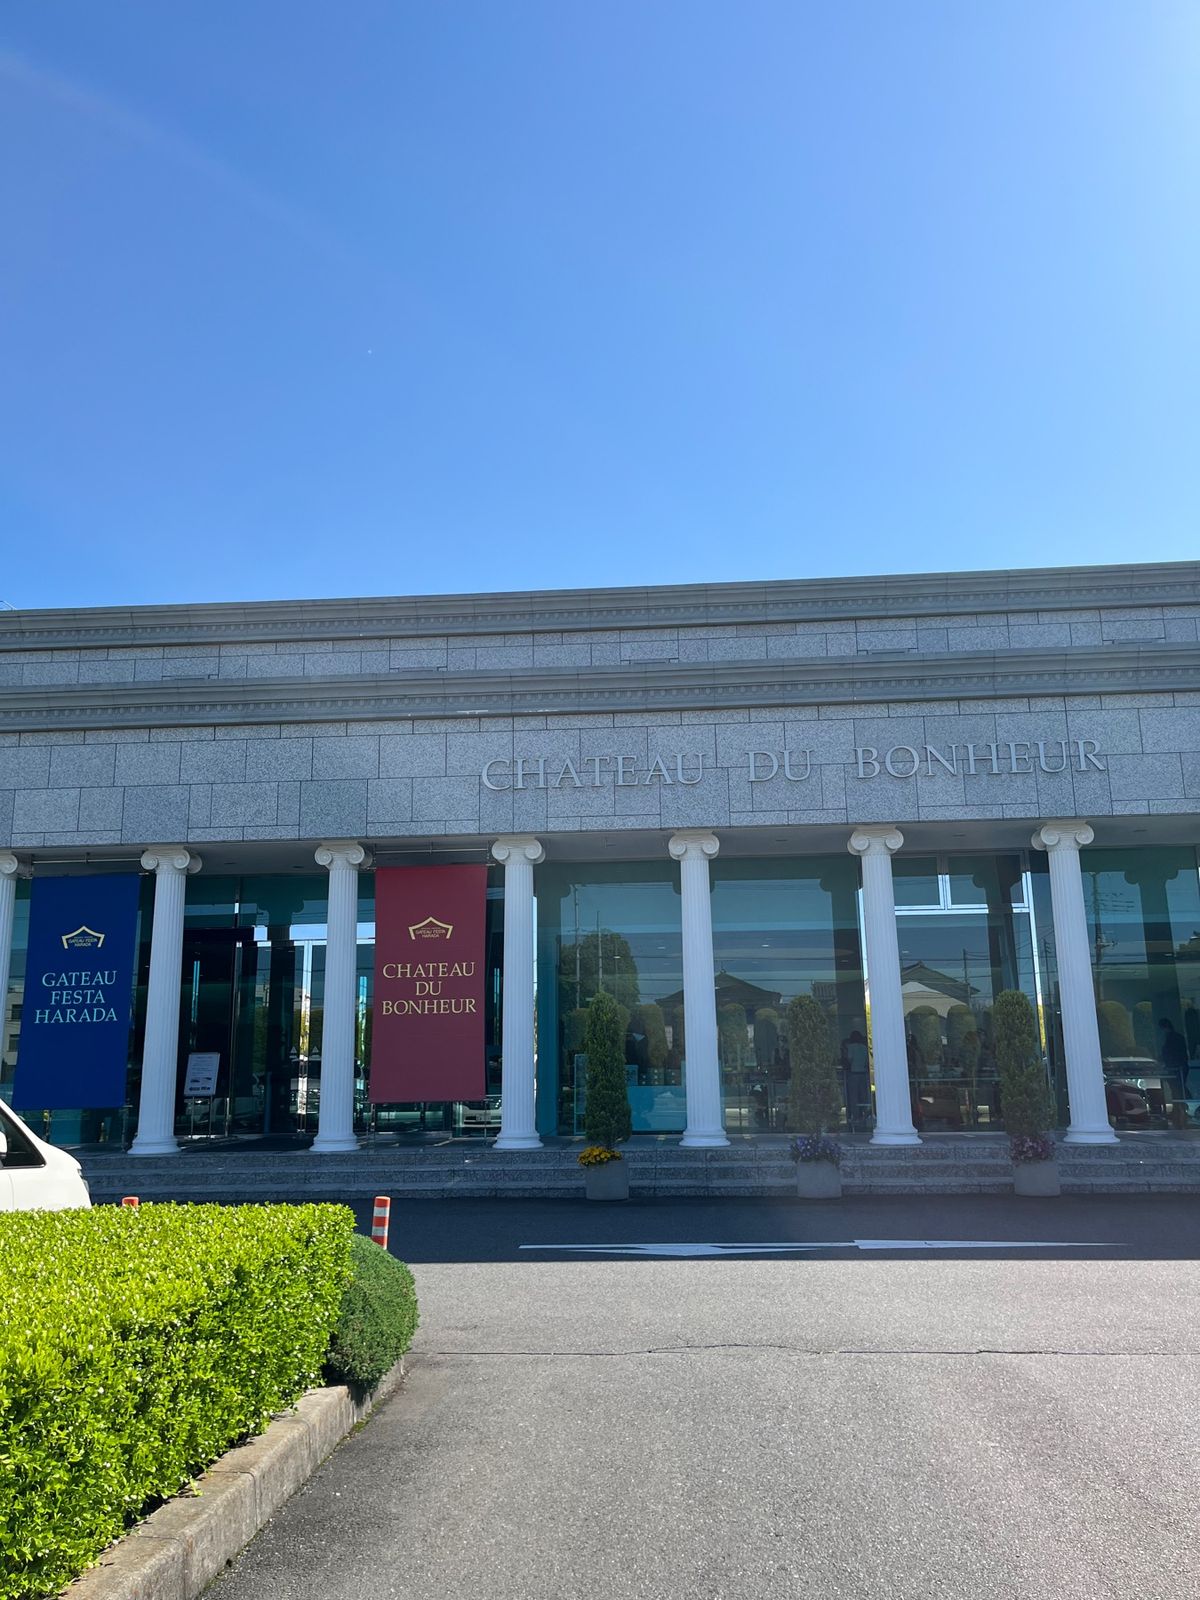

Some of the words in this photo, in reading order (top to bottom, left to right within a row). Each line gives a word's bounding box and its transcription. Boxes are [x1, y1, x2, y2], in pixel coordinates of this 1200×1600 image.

[481, 752, 706, 791] CHATEAU
[745, 749, 814, 783] DU
[854, 739, 1106, 780] BONHEUR
[42, 970, 118, 987] GATEAU
[382, 961, 475, 979] CHATEAU
[415, 980, 442, 996] DU
[50, 989, 106, 1005] FESTA
[382, 998, 477, 1015] BONHEUR
[34, 1007, 118, 1024] HARADA
